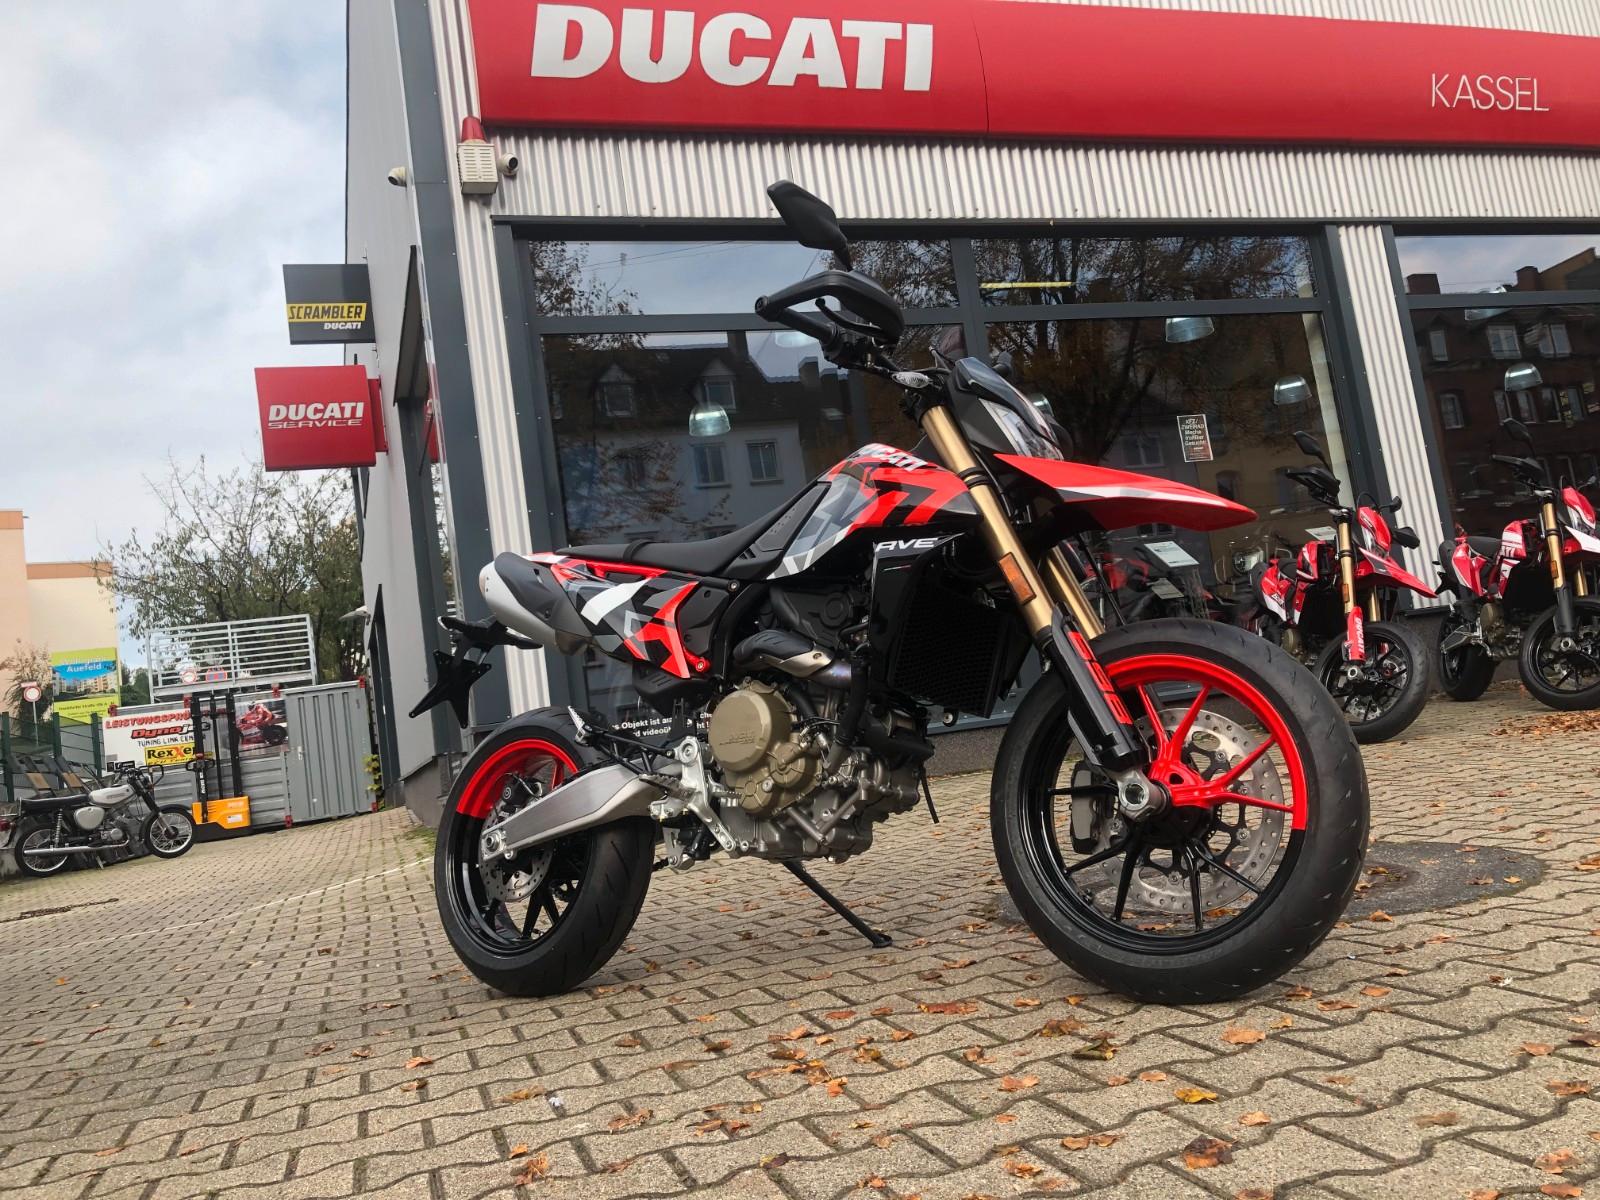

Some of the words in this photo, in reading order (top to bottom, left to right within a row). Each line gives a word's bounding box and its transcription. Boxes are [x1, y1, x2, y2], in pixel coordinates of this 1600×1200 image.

[531, 3, 934, 91] DUCATI
[1431, 73, 1550, 111] KASSEL
[288, 305, 363, 320] SCRAMBLER
[324, 322, 361, 330] DUCATI
[268, 402, 364, 420] DUCATI
[268, 419, 362, 429] SERVICE
[1354, 616, 1365, 654] DUCATI
[67, 662, 102, 673] Auefeld
[105, 708, 193, 729] LEISTUNGSPRÜ
[621, 720, 648, 729] Objekt
[131, 721, 211, 739] Dynoj
